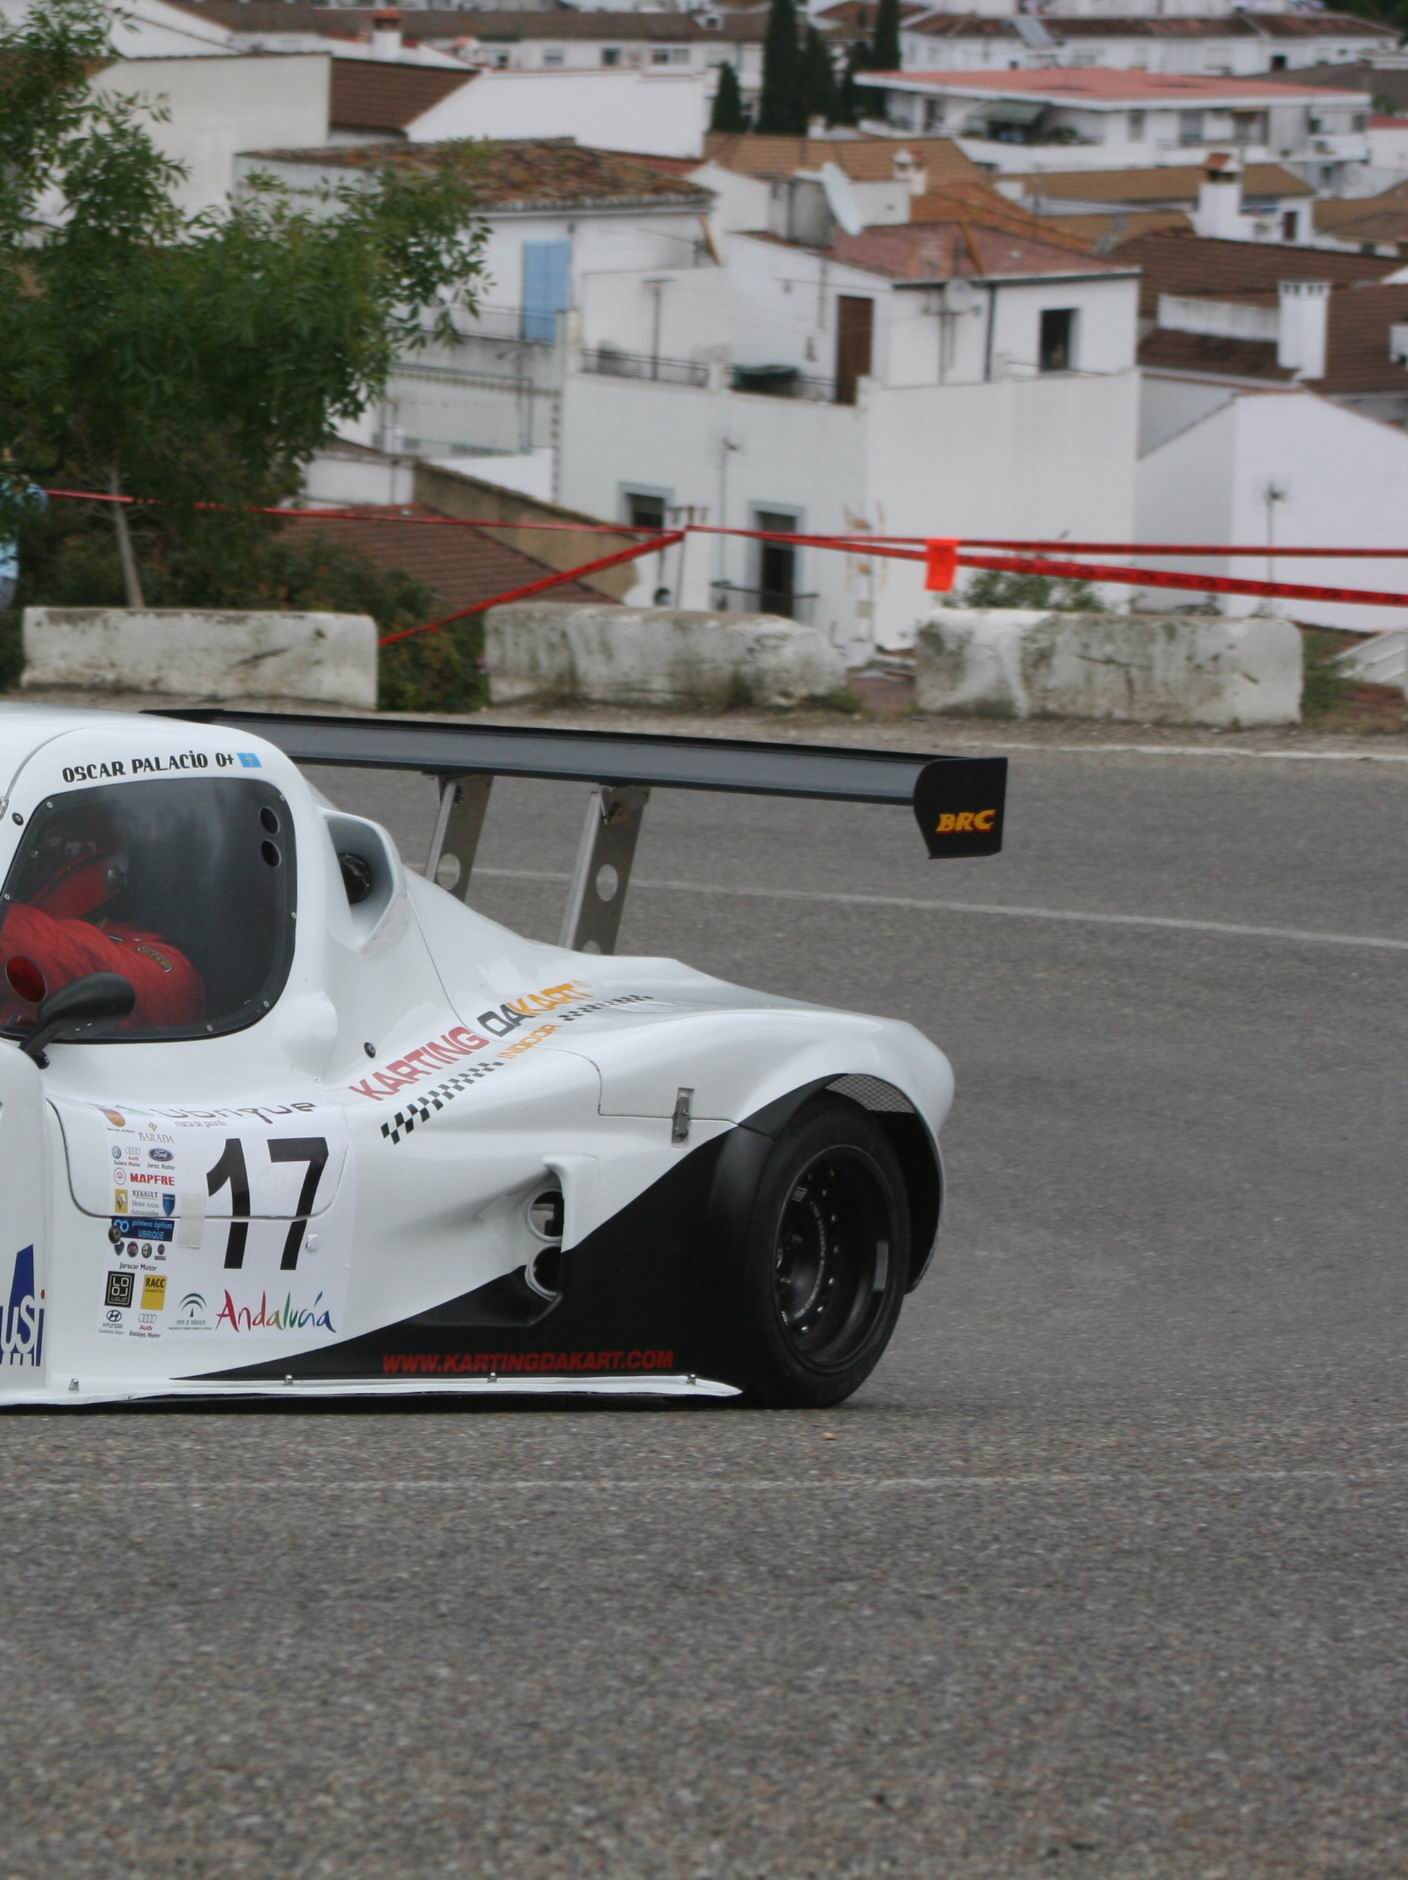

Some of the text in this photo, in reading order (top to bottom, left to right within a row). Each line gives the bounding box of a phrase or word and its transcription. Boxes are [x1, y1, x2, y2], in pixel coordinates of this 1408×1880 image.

[62, 761, 126, 783] OSCAR
[935, 809, 997, 833] BRC
[348, 1025, 490, 1101] KARTING
[129, 1172, 175, 1186] MAPFRE
[206, 1137, 329, 1270] 17
[145, 1277, 166, 1289] RACC
[215, 1288, 337, 1334] Andalucía
[382, 1350, 674, 1374] WWW.KARTINGDAKART.COM
